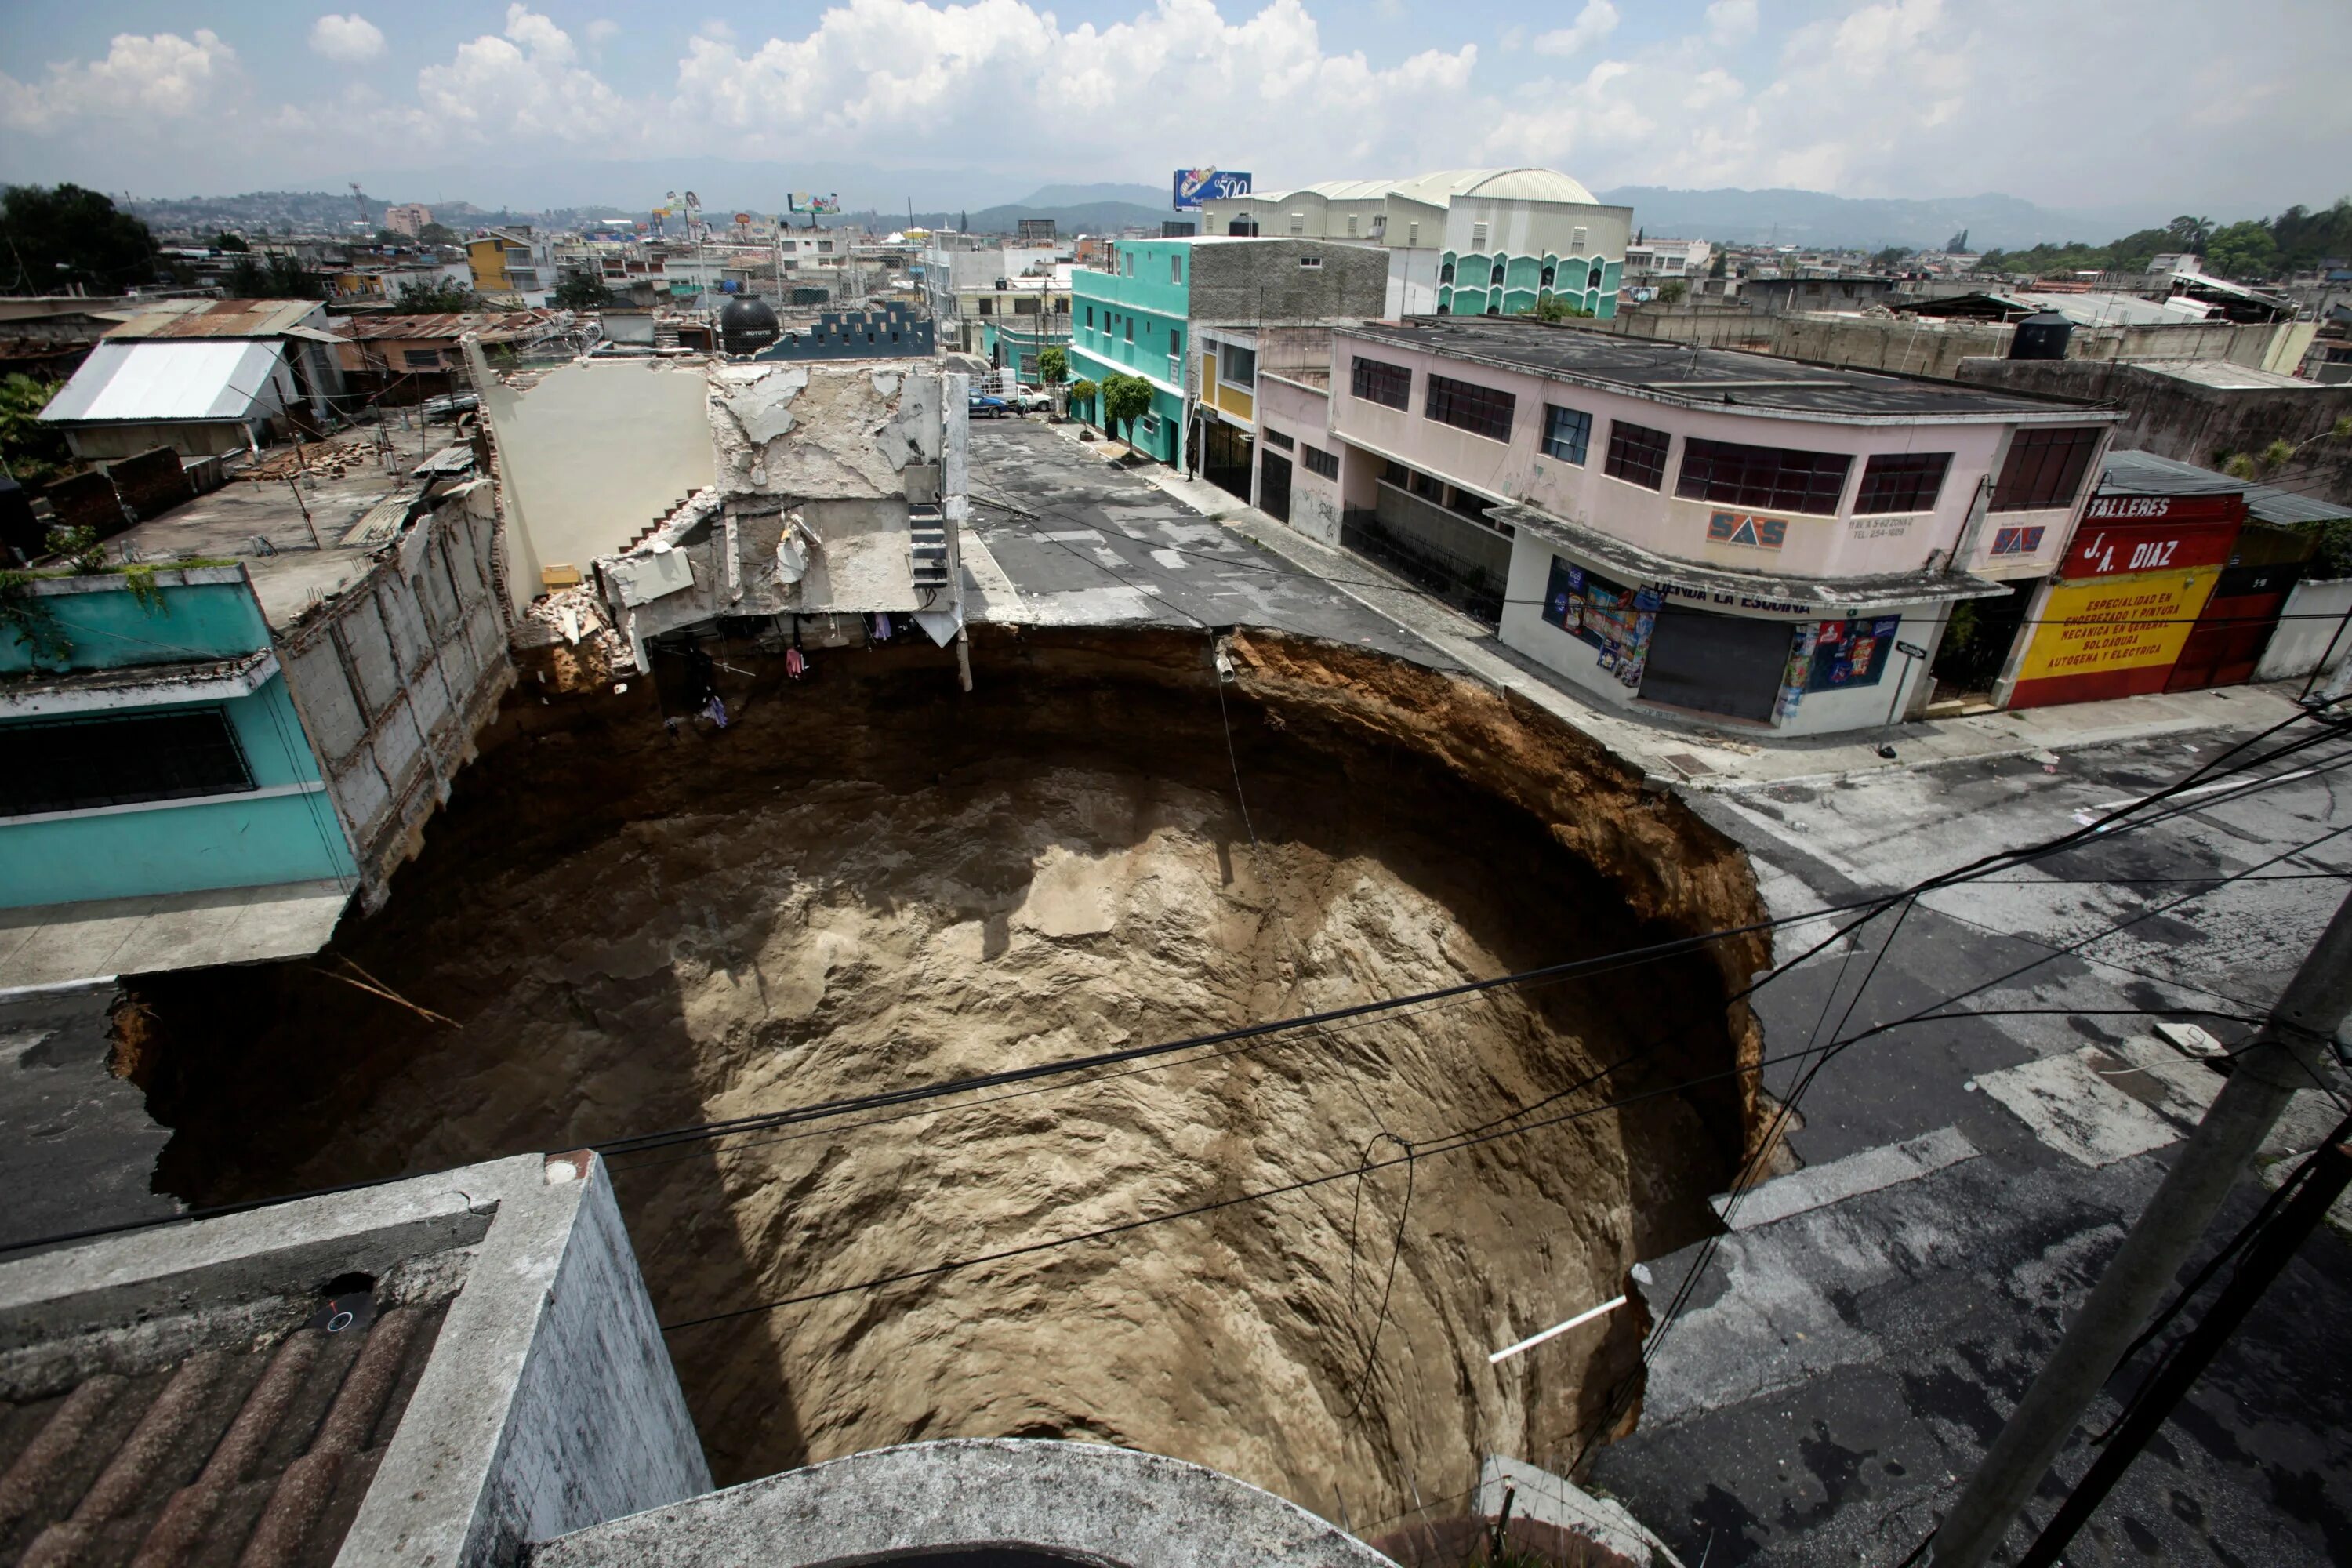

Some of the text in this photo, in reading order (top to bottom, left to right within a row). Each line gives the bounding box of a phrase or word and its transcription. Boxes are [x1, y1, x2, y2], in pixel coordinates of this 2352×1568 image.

[2086, 497, 2170, 518] TALLERES
[1710, 514, 1788, 546] SAS
[1993, 527, 2044, 553] SAS
[2084, 532, 2180, 572] J. A. DIAZ
[2085, 593, 2172, 612] ESPECIALIDAD EN
[2131, 609, 2138, 619] Y
[2140, 604, 2180, 619] PINTURA
[2061, 627, 2110, 641] MECANICA
[2113, 623, 2125, 635] EN
[2082, 635, 2140, 652] SOLDADURA
[2047, 644, 2161, 668] AUTOGENA Y ELECTRICA
